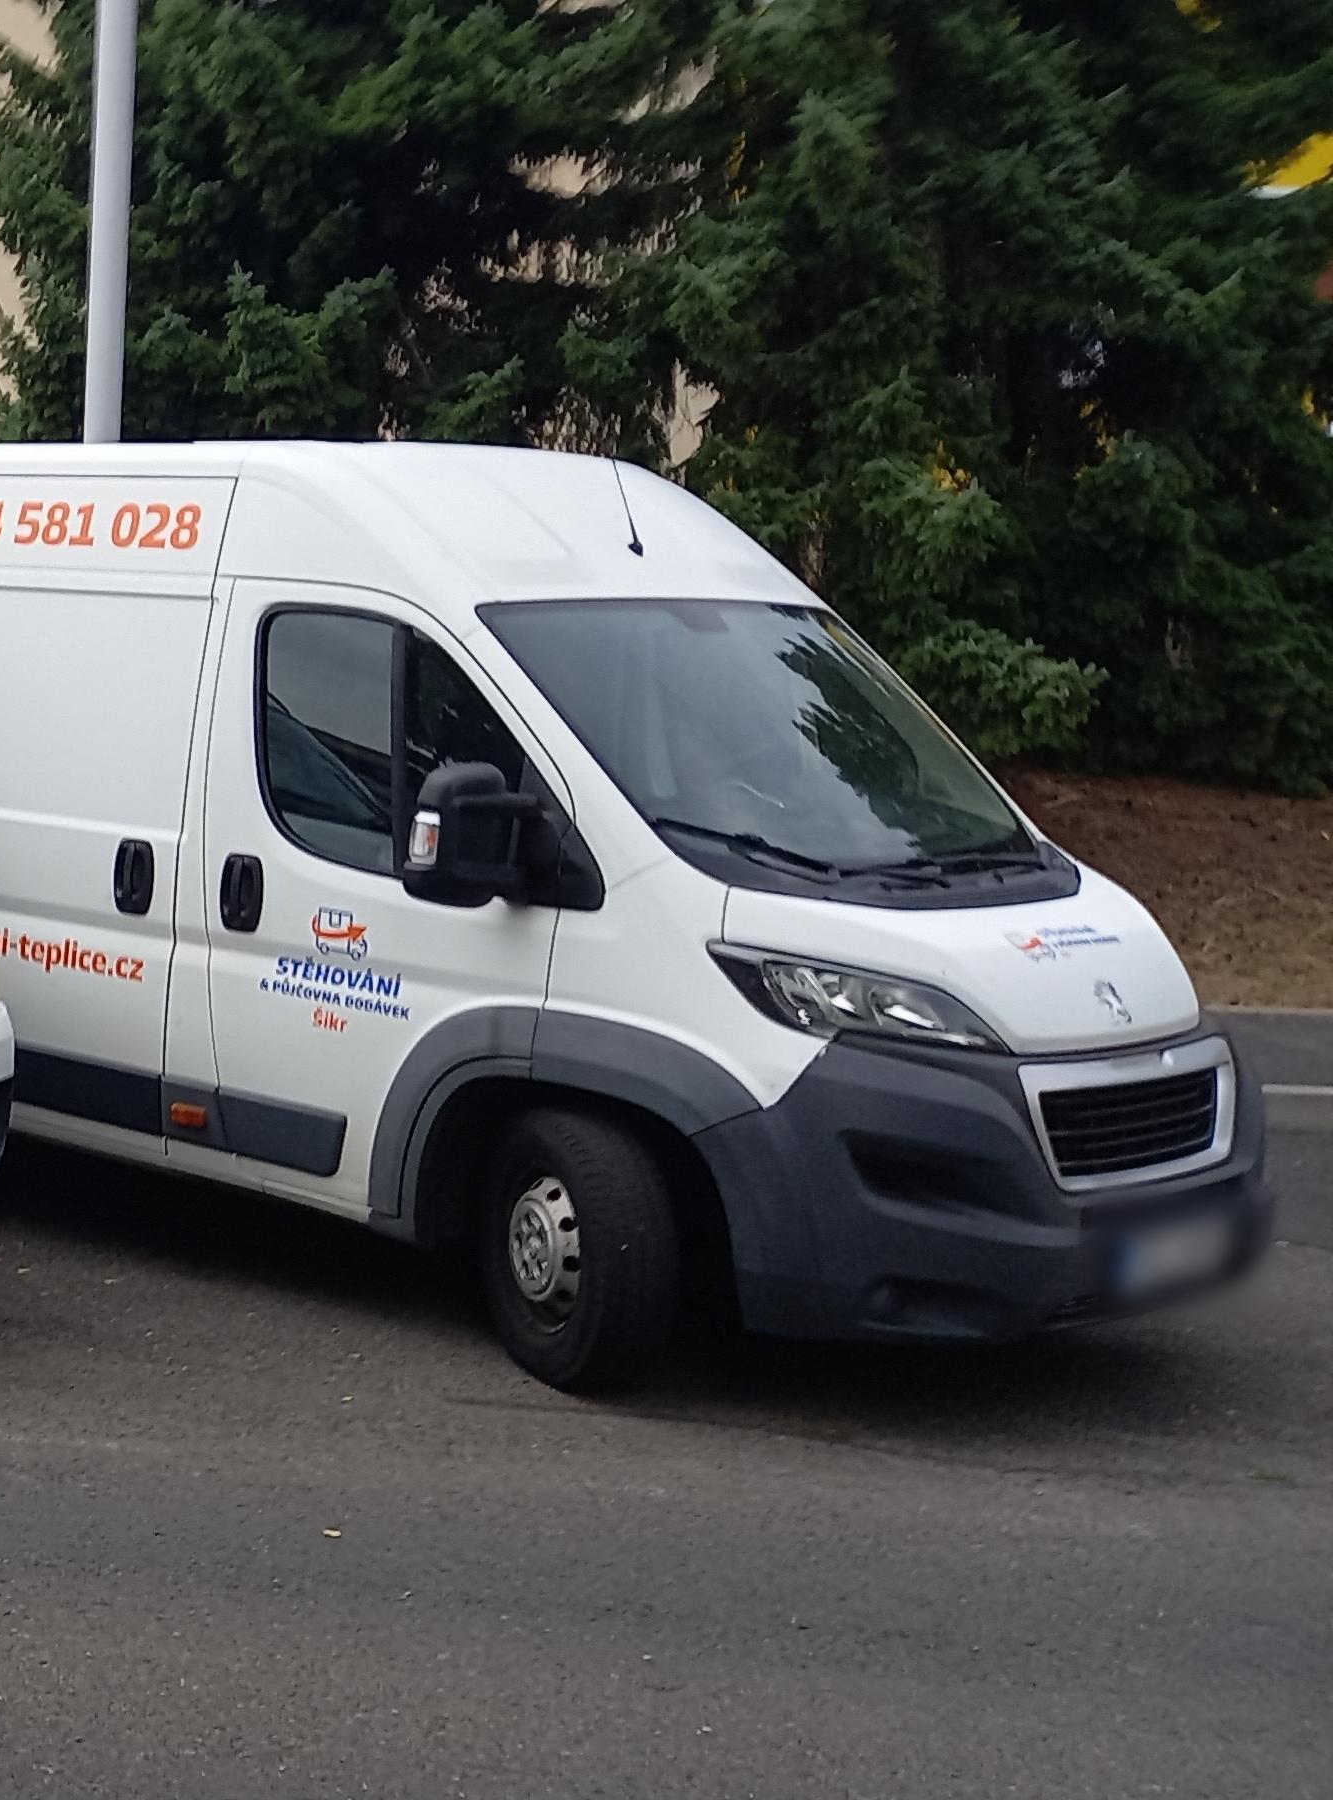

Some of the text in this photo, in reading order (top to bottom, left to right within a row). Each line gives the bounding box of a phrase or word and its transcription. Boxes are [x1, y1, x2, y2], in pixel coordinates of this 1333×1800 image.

[14, 502, 95, 546] 581
[111, 503, 201, 550] 028
[272, 976, 341, 1007] PŮJČOVNA
[345, 995, 411, 1021] DODÁVEK
[275, 955, 402, 999] STĚHOVÁNÍ
[312, 1006, 348, 1033] Šikr
